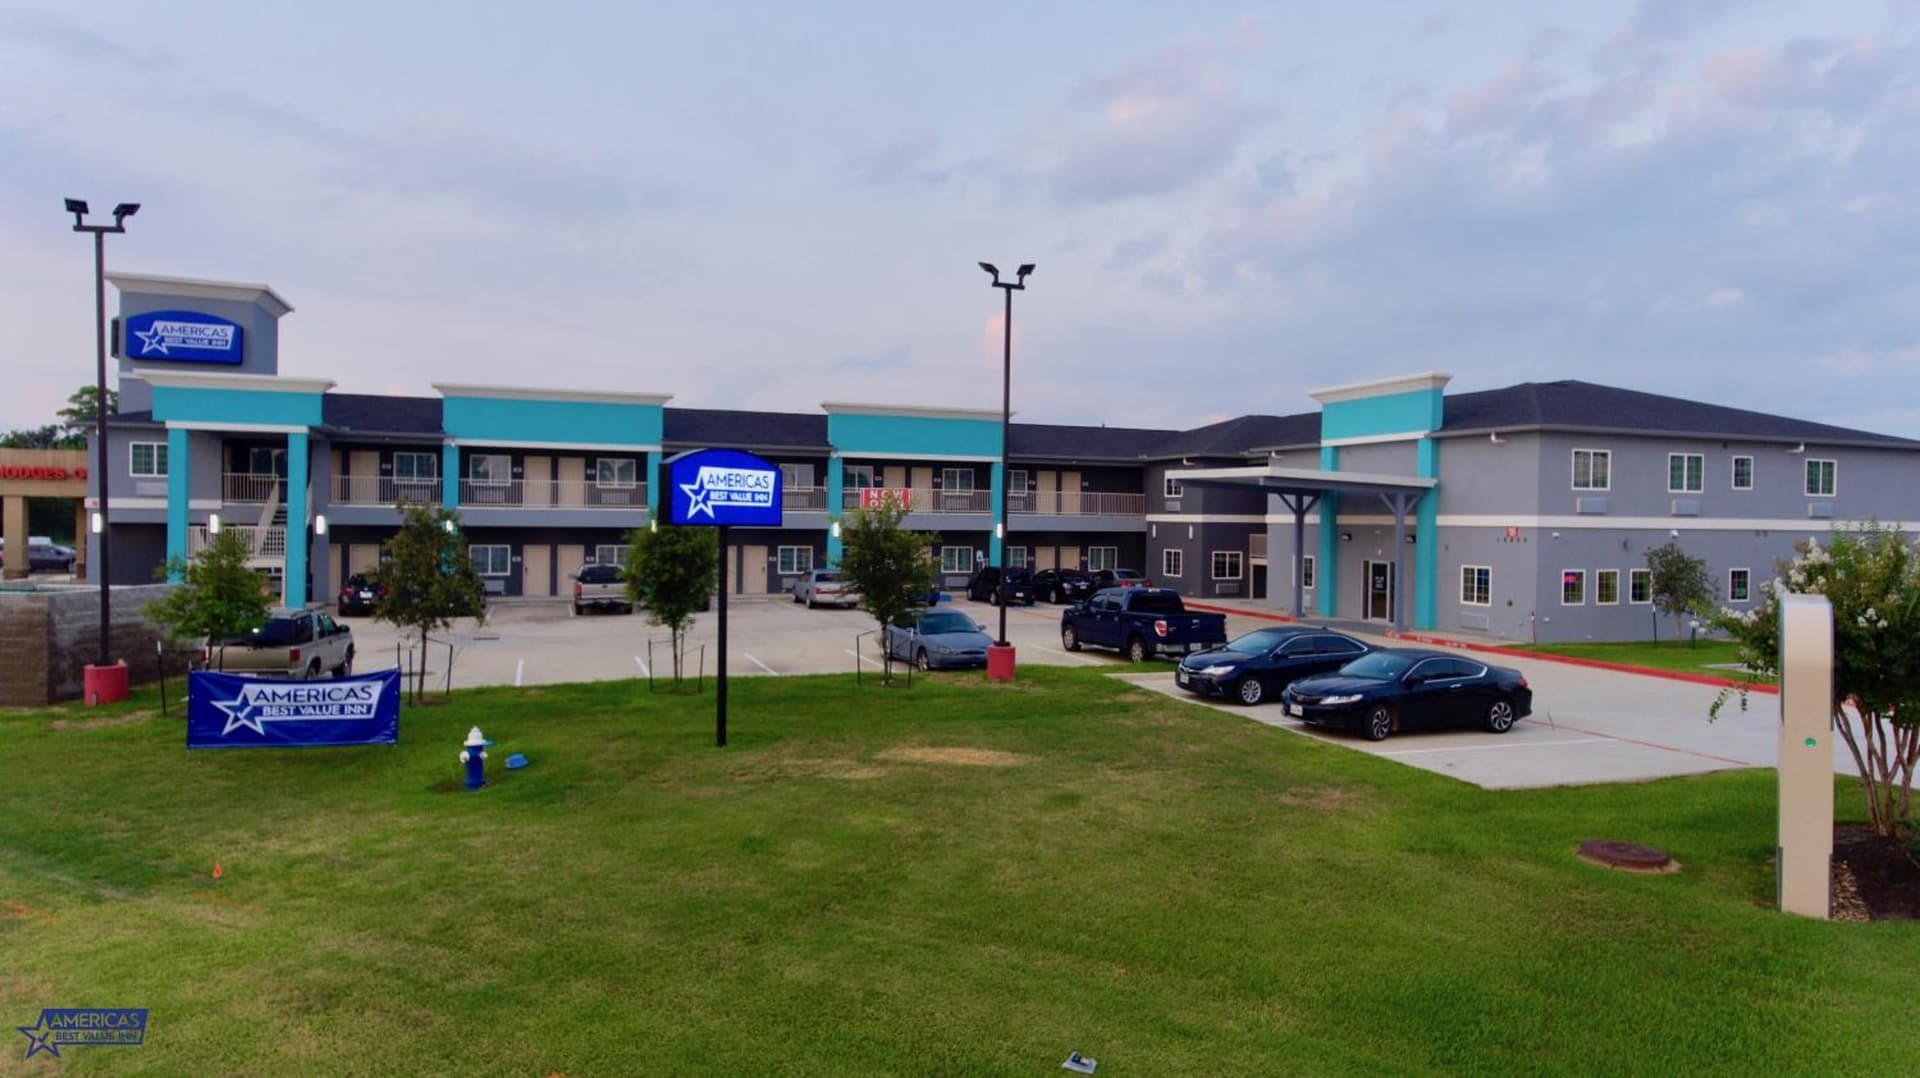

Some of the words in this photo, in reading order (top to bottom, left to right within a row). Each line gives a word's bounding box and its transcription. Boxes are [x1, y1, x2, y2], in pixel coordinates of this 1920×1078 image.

[160, 325, 229, 338] AMERICAS
[707, 473, 769, 489] AMERICAS
[710, 490, 727, 501] BEST
[728, 491, 752, 502] VALUE
[754, 493, 768, 502] INN
[253, 685, 373, 703] AMERICAS
[262, 704, 295, 717] BEST
[299, 704, 340, 716] VALUE
[344, 704, 368, 715] INN
